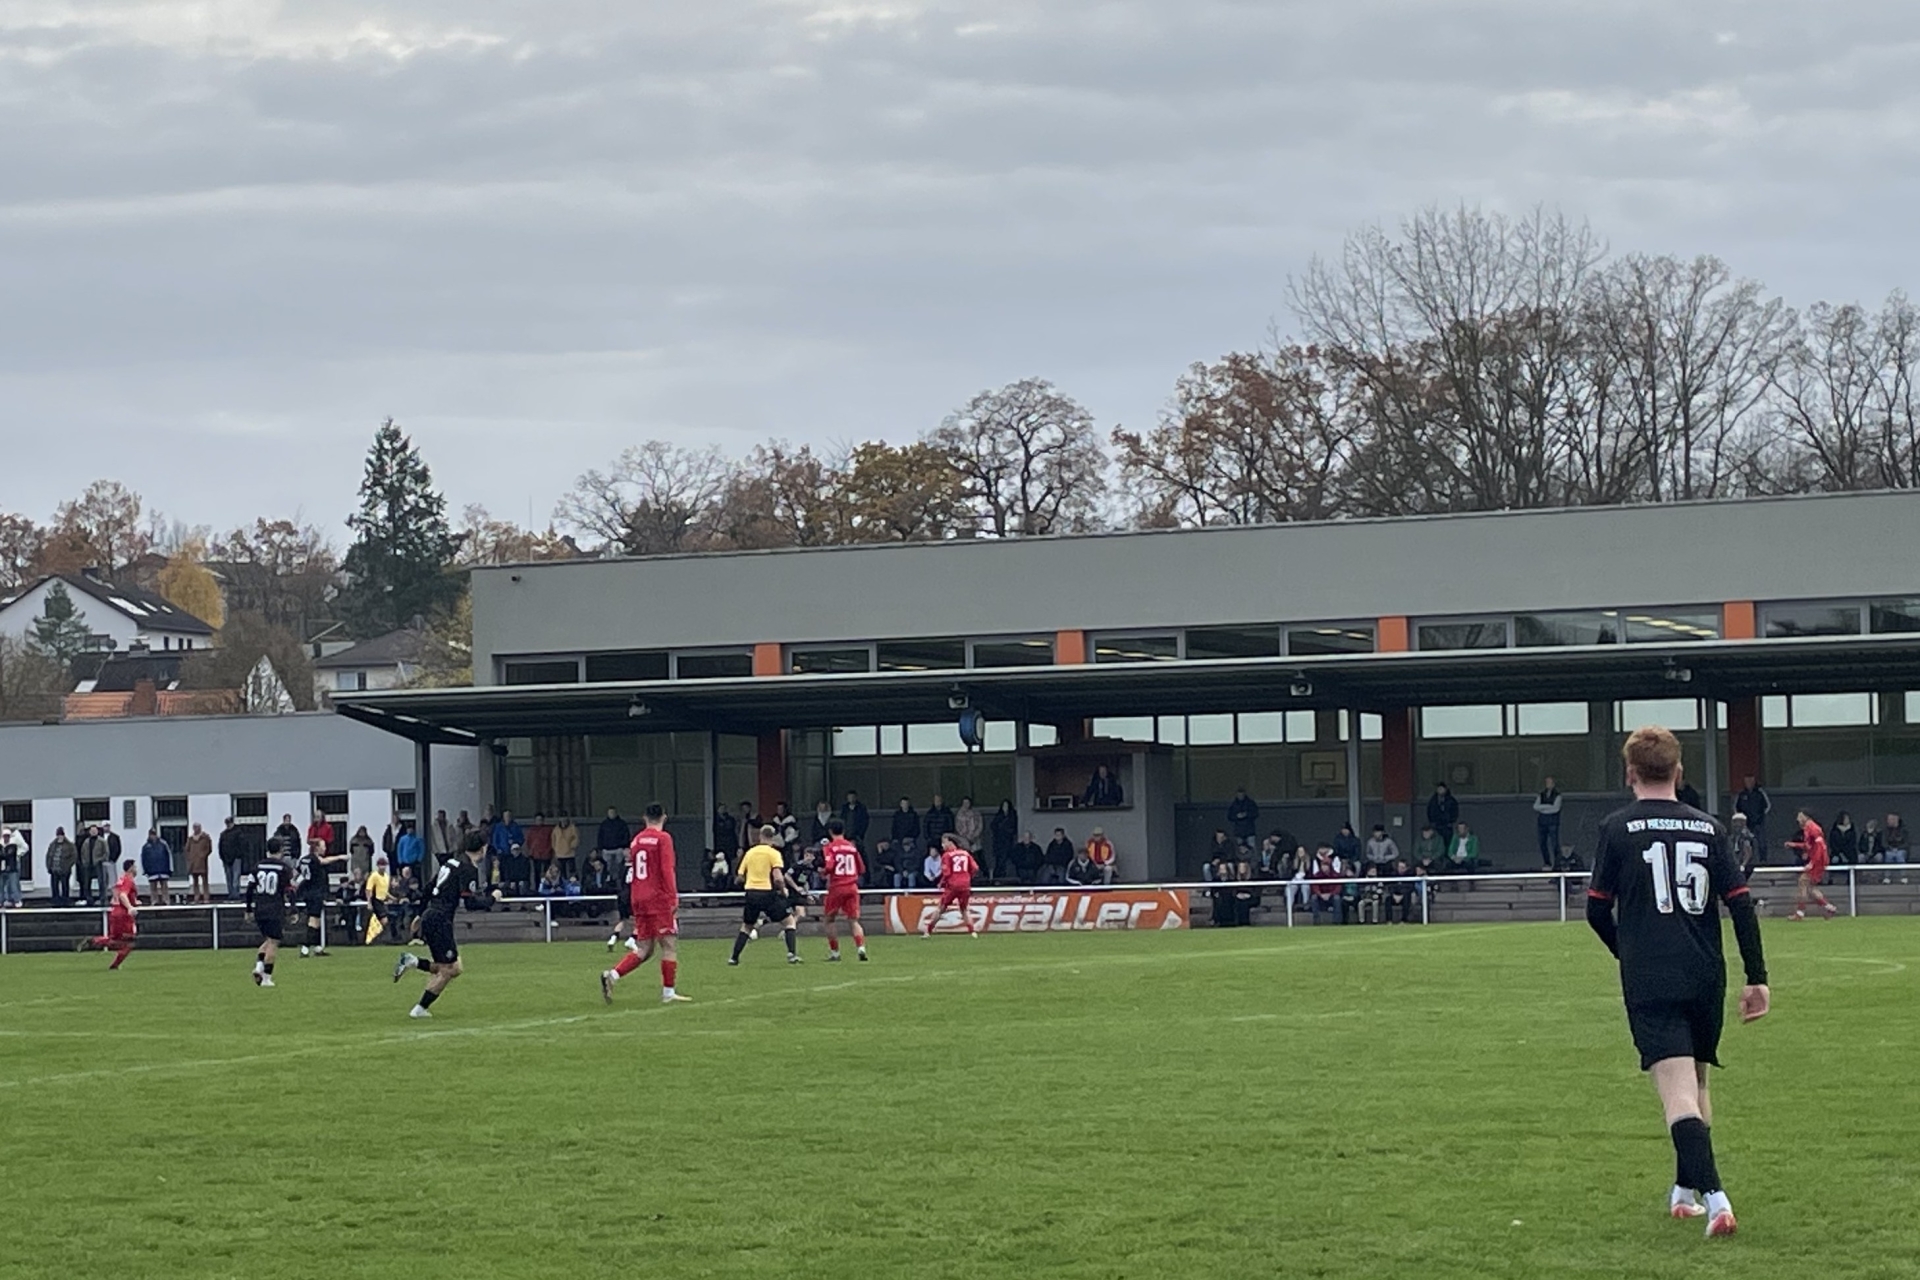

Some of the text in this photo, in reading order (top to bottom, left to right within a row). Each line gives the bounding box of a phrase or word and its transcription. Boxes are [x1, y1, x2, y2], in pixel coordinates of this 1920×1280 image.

[636, 850, 648, 880] 6
[835, 853, 856, 876] 20
[1642, 841, 1710, 915] 15
[256, 870, 279, 895] 30
